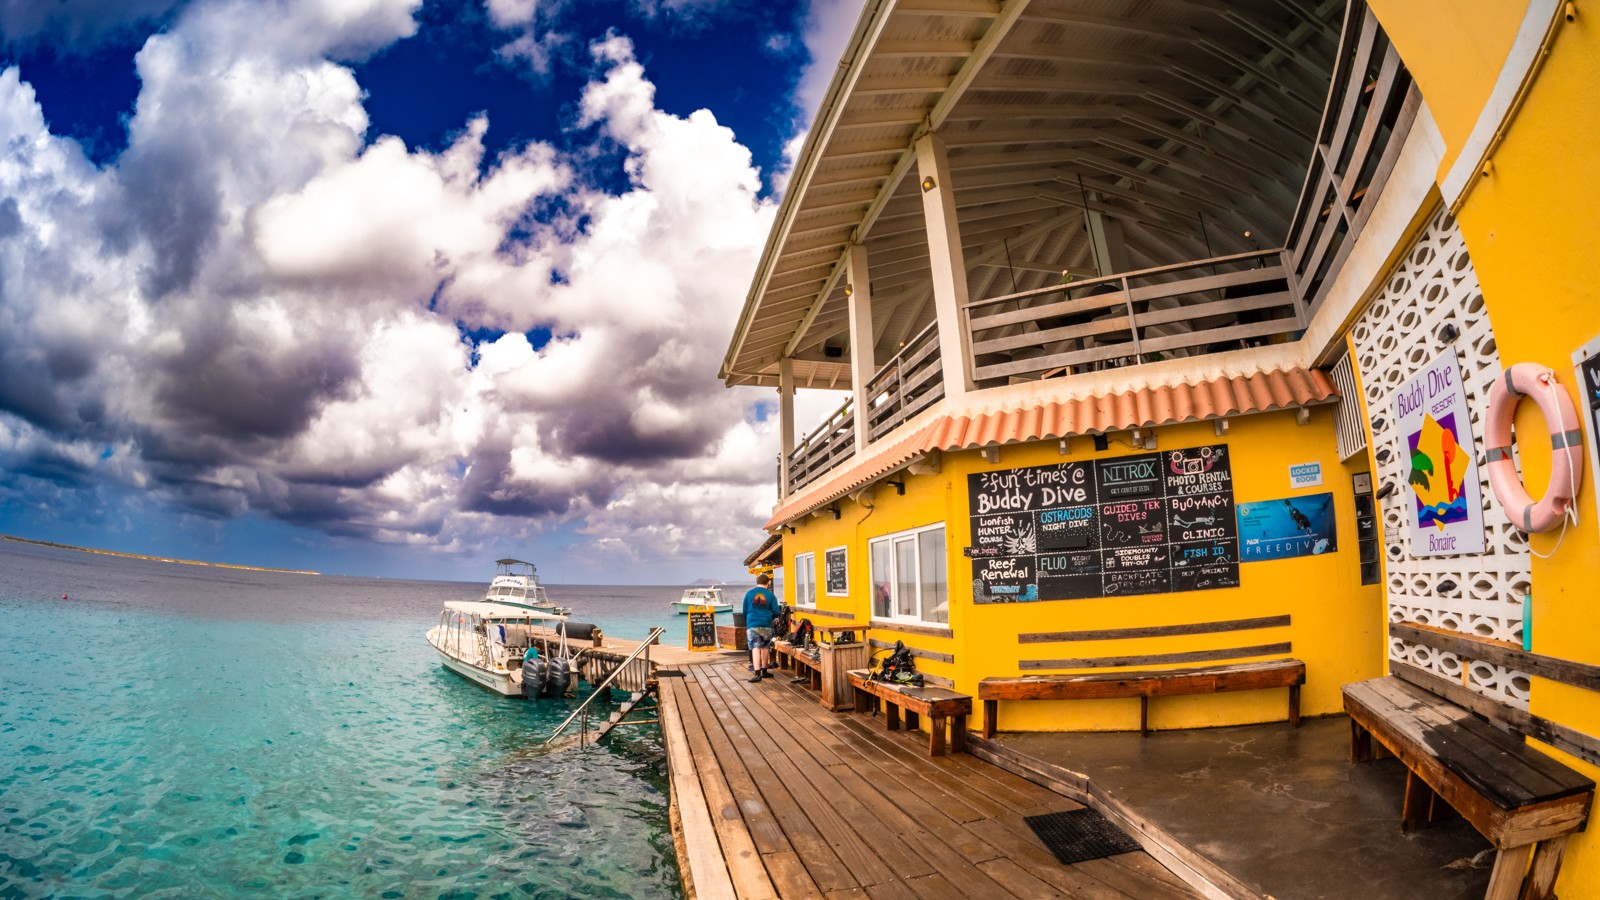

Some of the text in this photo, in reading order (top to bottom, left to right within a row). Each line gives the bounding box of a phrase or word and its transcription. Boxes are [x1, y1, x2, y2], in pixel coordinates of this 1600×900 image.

[1397, 366, 1452, 419] Buddy Dive
[1431, 392, 1456, 416] RESORT
[1103, 462, 1155, 482] NITROX
[1291, 466, 1319, 475] LOCKER
[990, 467, 1085, 493] fun times @
[1167, 470, 1231, 487] PHOTO RENTAL
[1295, 475, 1318, 484] ROOM
[1177, 482, 1223, 495] & COURSES
[977, 486, 1087, 514] Buddy Dive
[1172, 495, 1229, 512] BUOYANCY
[1103, 501, 1160, 516] GUIDED TEK
[1041, 507, 1092, 524] OSTRACODS
[1118, 512, 1147, 523] DIVES
[978, 525, 1012, 536] HUNTER
[1042, 519, 1089, 532] NIGHT DIVE
[979, 536, 1003, 544] COURSE
[1182, 527, 1225, 540] CLINIC
[1429, 534, 1456, 552] Bonaire
[1120, 554, 1151, 562] DOUBLES
[1184, 546, 1224, 558] FISH ID
[988, 559, 1016, 570] Reef
[1041, 557, 1067, 571] FLUO
[981, 567, 1028, 581] Renewal
[1112, 572, 1163, 582] BACKPLATE
